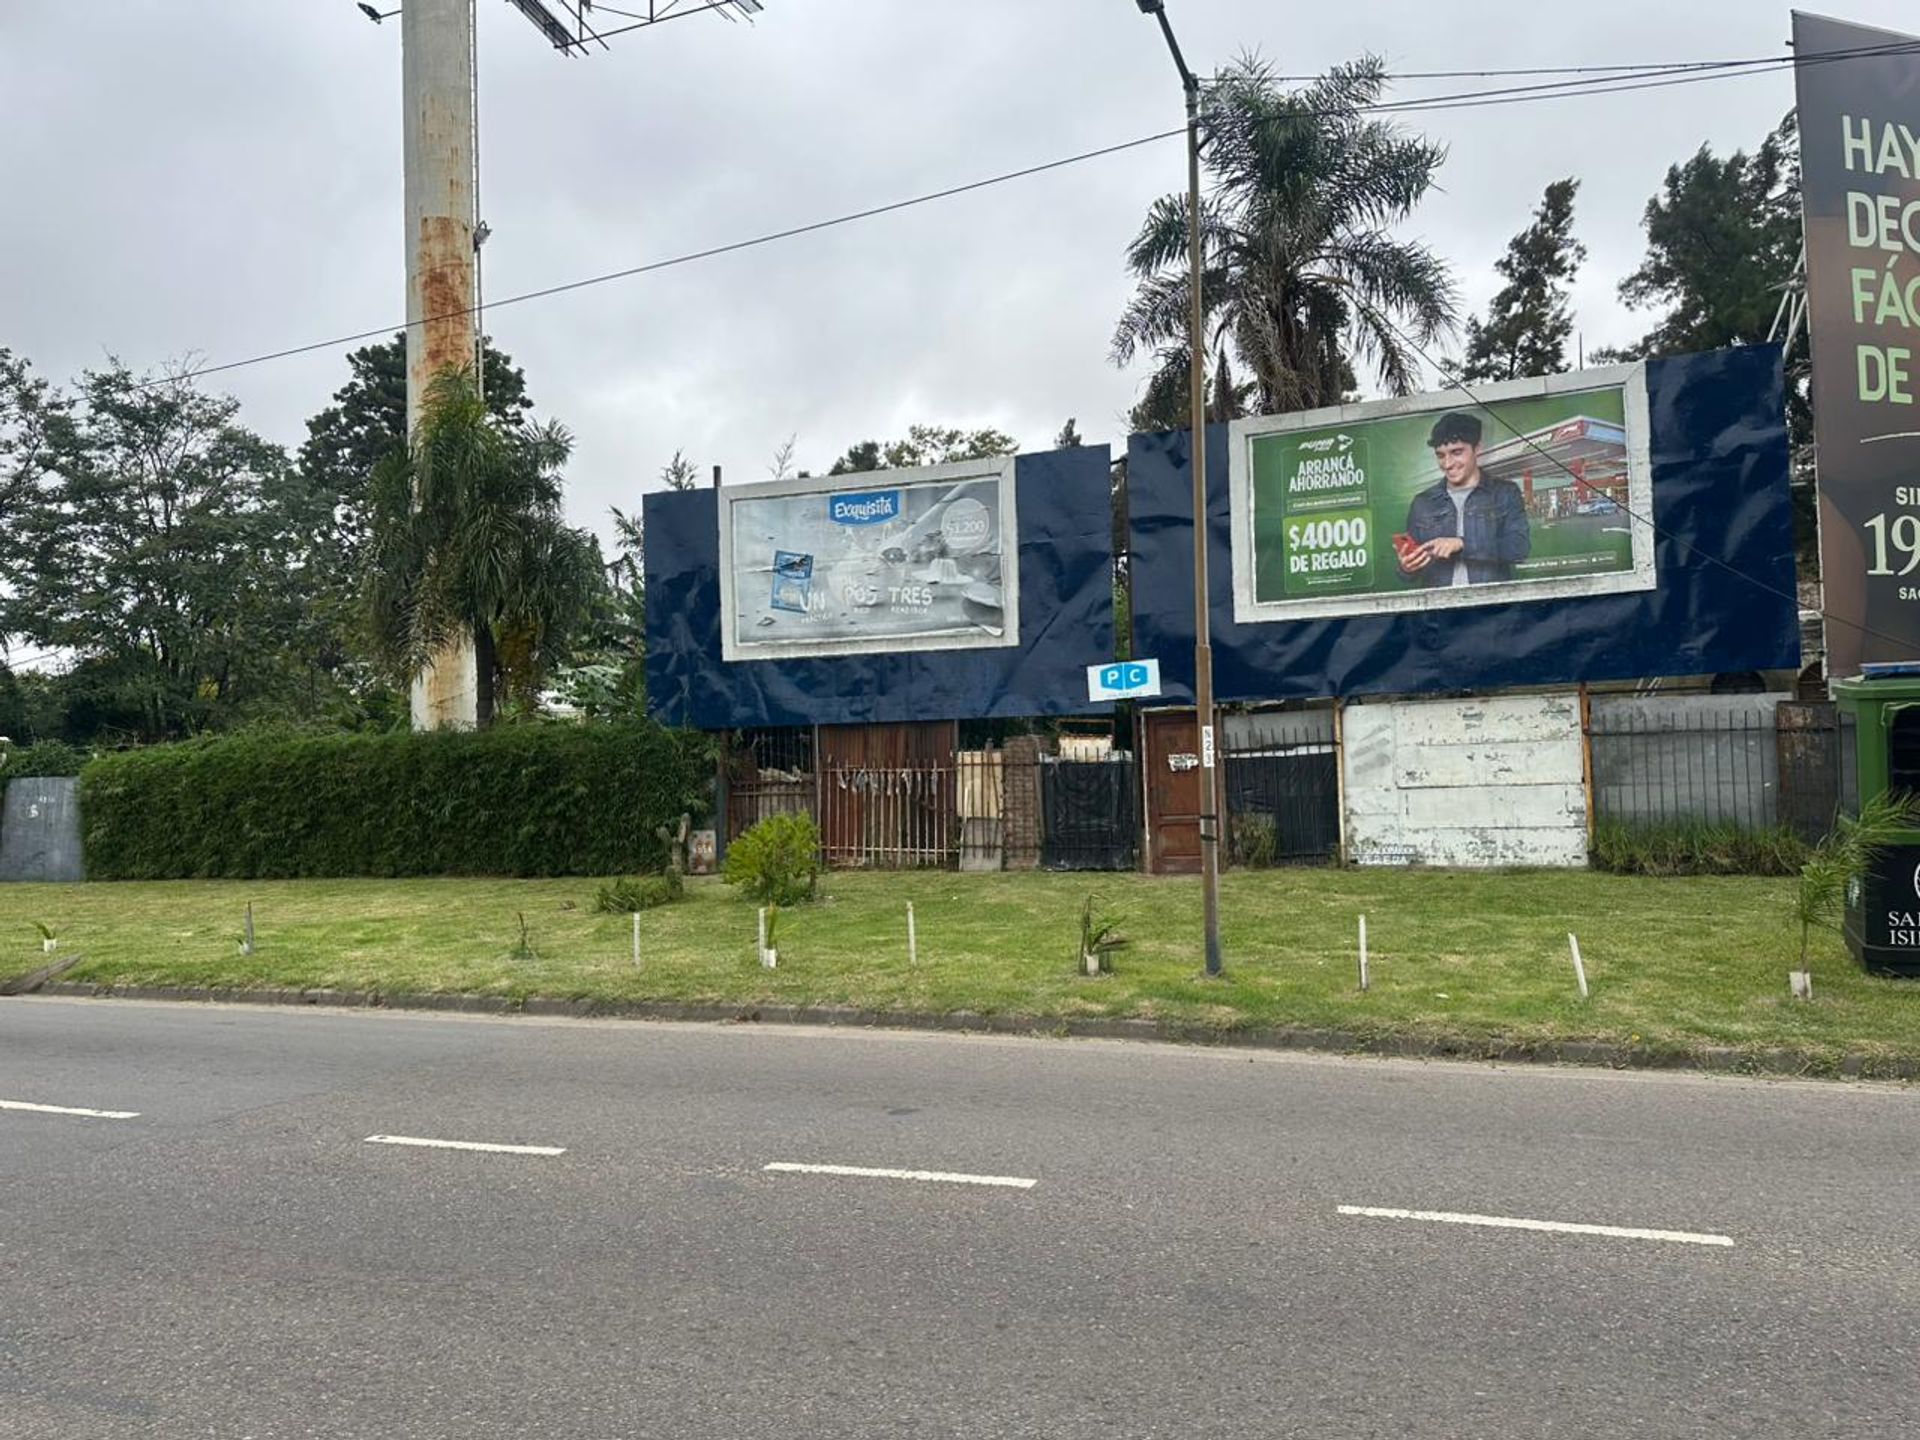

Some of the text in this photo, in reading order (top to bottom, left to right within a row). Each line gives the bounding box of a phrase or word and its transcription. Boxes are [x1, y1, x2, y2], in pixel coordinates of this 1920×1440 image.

[1842, 115, 1920, 180] HAY
[1857, 344, 1913, 404] DE
[1298, 451, 1355, 476] ARRANCÁ
[1288, 468, 1365, 493] AHORRANDO
[834, 496, 893, 521] Exquisita
[1288, 516, 1367, 552] $4000
[1290, 548, 1367, 574] DE REGALO
[888, 586, 933, 606] TRES
[1898, 587, 1920, 600] SA
[1888, 910, 1920, 927] SA
[1889, 929, 1920, 946] ISI
